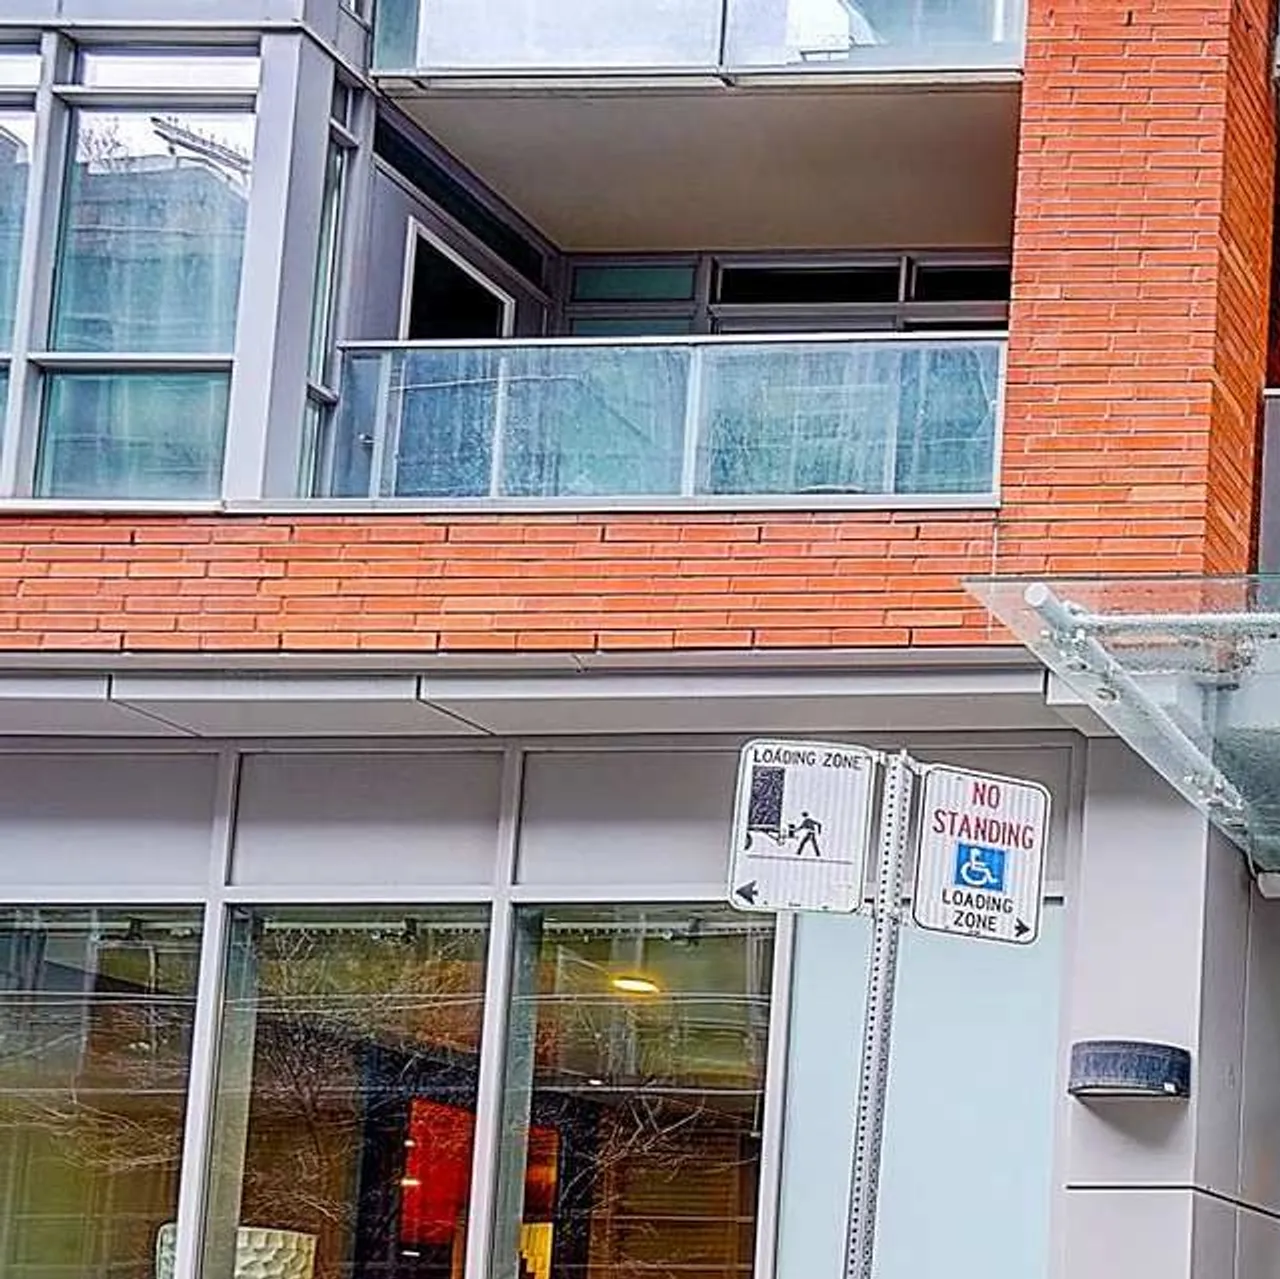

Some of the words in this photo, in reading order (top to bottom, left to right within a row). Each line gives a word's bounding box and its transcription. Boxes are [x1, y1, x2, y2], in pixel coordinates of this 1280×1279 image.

[753, 747, 817, 767] LOADING
[822, 750, 864, 770] ZONE
[971, 781, 1001, 810] NO
[932, 809, 1036, 850] STANDING
[942, 887, 1014, 914] LOADING
[953, 910, 998, 933] ZONE
